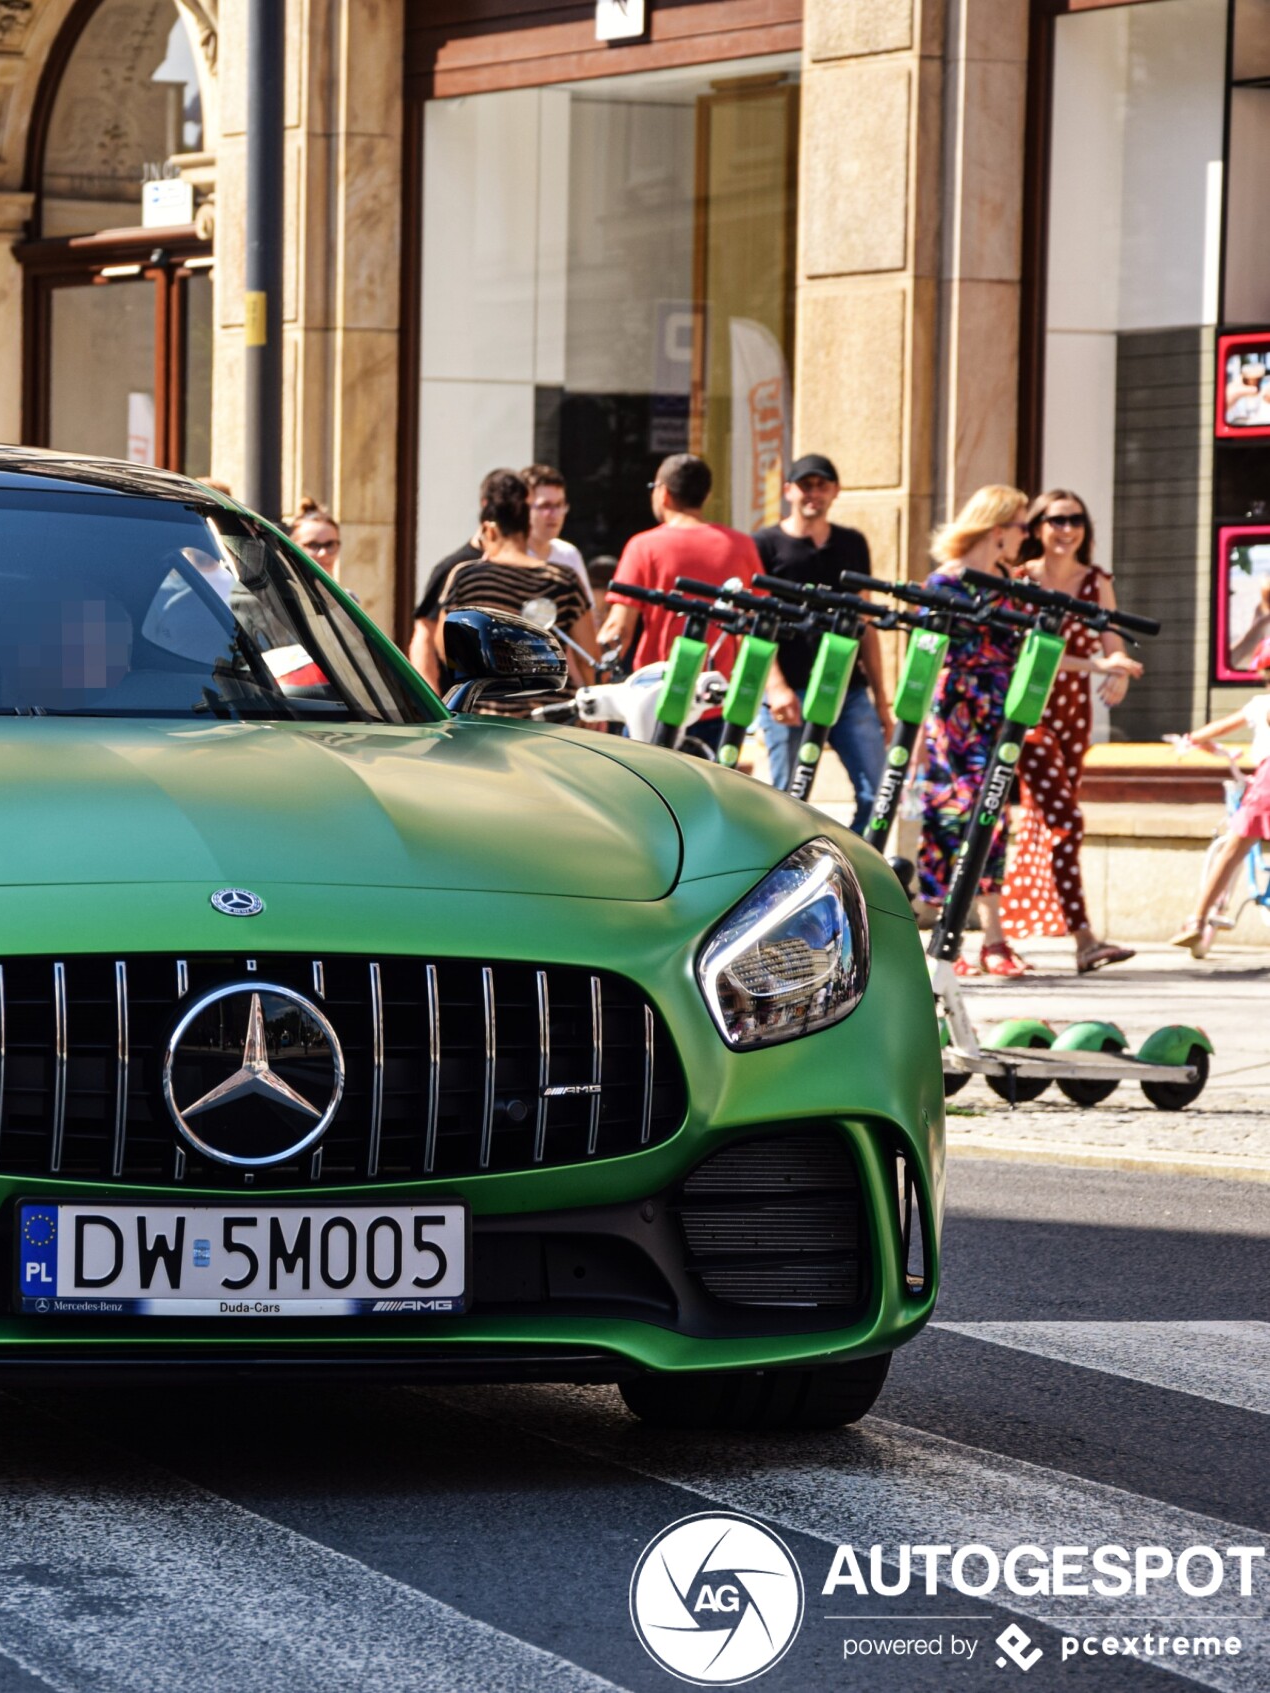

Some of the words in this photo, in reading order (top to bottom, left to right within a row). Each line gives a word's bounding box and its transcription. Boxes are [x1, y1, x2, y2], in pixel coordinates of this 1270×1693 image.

[74, 1215, 185, 1289] DW
[221, 1215, 447, 1290] 5M005
[26, 1262, 52, 1282] PL
[54, 1301, 123, 1312] Mercedes-Benz
[220, 1302, 280, 1313] Duda-Cars
